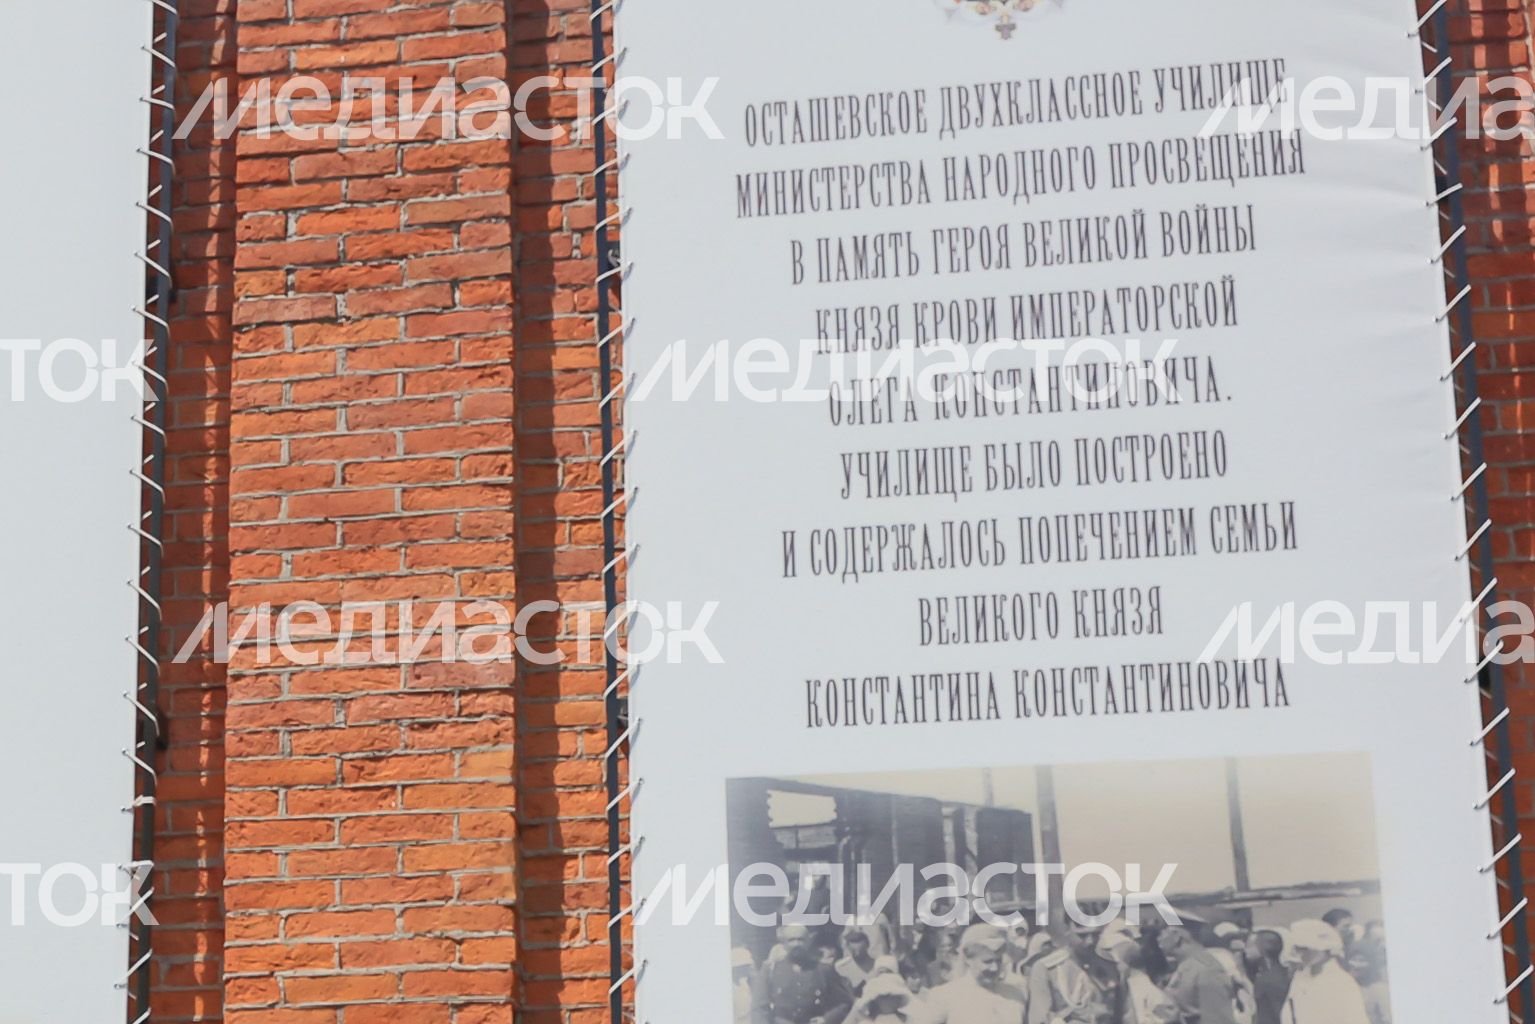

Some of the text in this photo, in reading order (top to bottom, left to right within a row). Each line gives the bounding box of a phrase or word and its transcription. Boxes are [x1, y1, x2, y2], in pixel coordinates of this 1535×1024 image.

[744, 58, 1290, 148] ОСТАШЕВСКОЕ ДВУХКЛАССНОЕ УЧИЛИЩЕ
[736, 128, 1306, 219] МИНИСТЕРСТВА НАРОДНОГО ПРОСВЕЩЕНИЯ
[789, 203, 1256, 285] В ПАМЯТЬ ГЕРОЯ ВЕЛИКОЙ ВОЙНЫ
[815, 273, 1239, 354] КНЯЗЯ КРОВИ ИМПЕРАТОРСКОЙ
[827, 355, 1232, 427] ОЛЕГА КОНСТАНТИНОВИЧА.
[839, 429, 1229, 502] УЧИЛИЩЕ БЫЛО ПОСТРОЕНО
[780, 500, 1299, 584] И СОДЕРЖАЛОСЬ ПОПЕЧЕНИЕМ СЕМЬИ
[917, 585, 1164, 647] ВЕЛИКОГО КНЯЗЯ
[805, 656, 1291, 729] КОНСТАНТИНА КОНСТАНТИНОВИЧА
